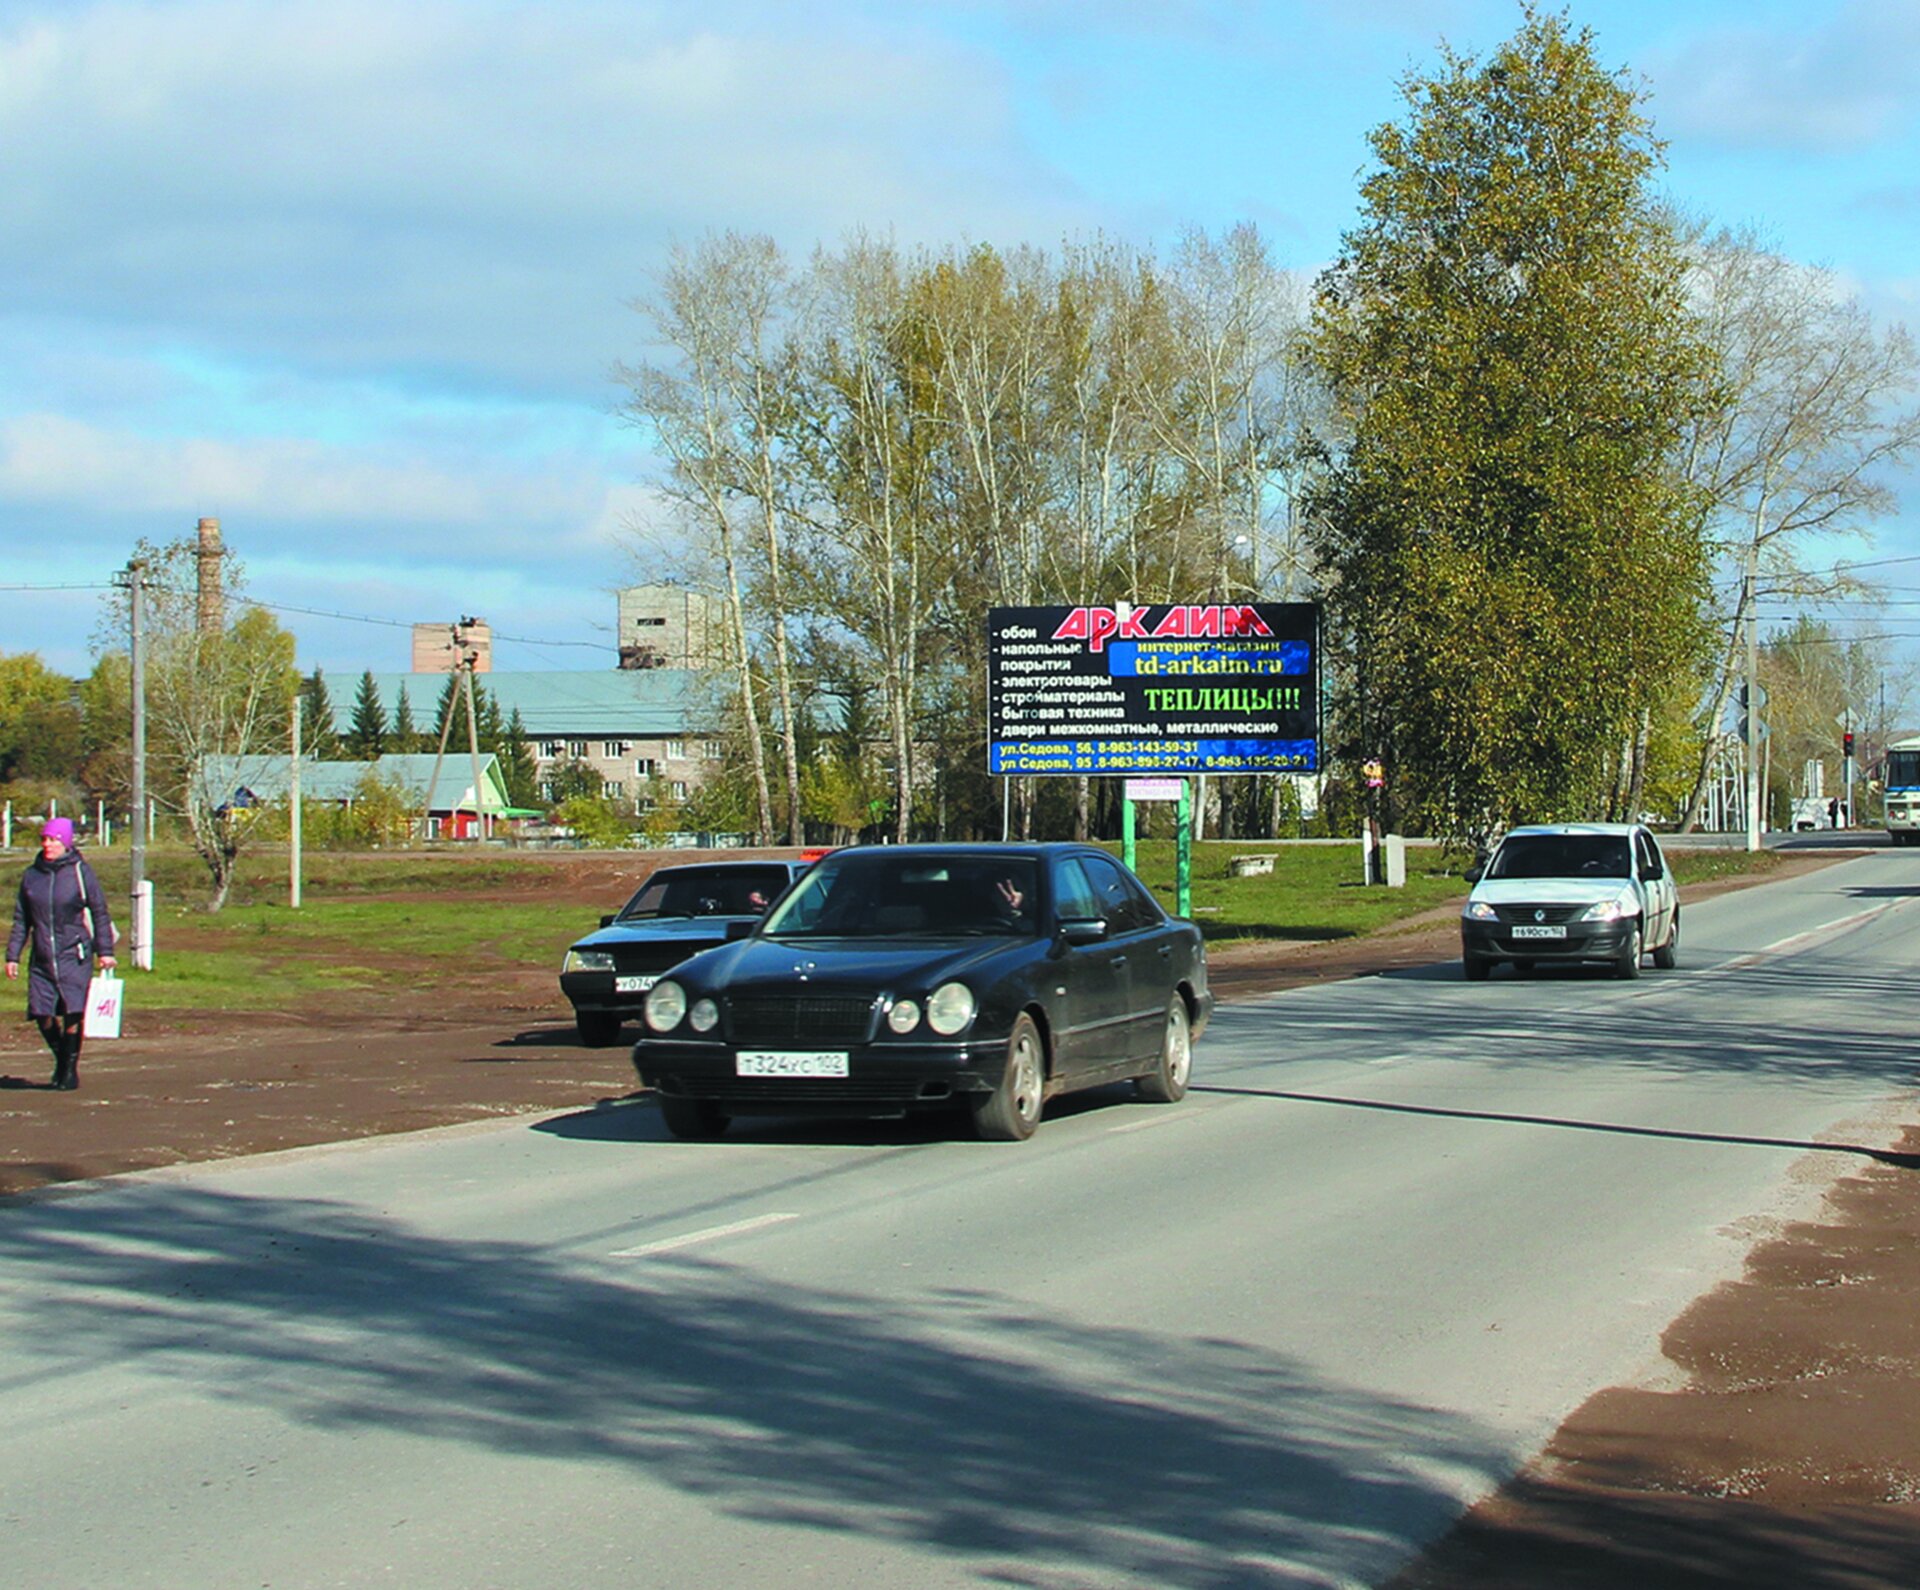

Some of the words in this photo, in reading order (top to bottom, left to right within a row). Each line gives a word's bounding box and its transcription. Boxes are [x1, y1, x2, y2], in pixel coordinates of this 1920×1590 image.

[1001, 626, 1037, 639] обои
[1051, 606, 1274, 653] АРКАИМ
[1001, 643, 1082, 655] напольные
[1001, 660, 1071, 673] покрытия
[1135, 655, 1283, 675] td-arkaim.ru
[1001, 676, 1112, 689] электротовары
[1001, 690, 1125, 706] стройматериалы
[1144, 688, 1300, 714] ТЕПЛИЦЫ!!!
[1001, 708, 1064, 720] бытовая
[1067, 708, 1125, 719] техника
[1001, 724, 1046, 738] двери
[1049, 722, 1163, 736] межкомнатные,
[1166, 722, 1279, 734] металлические
